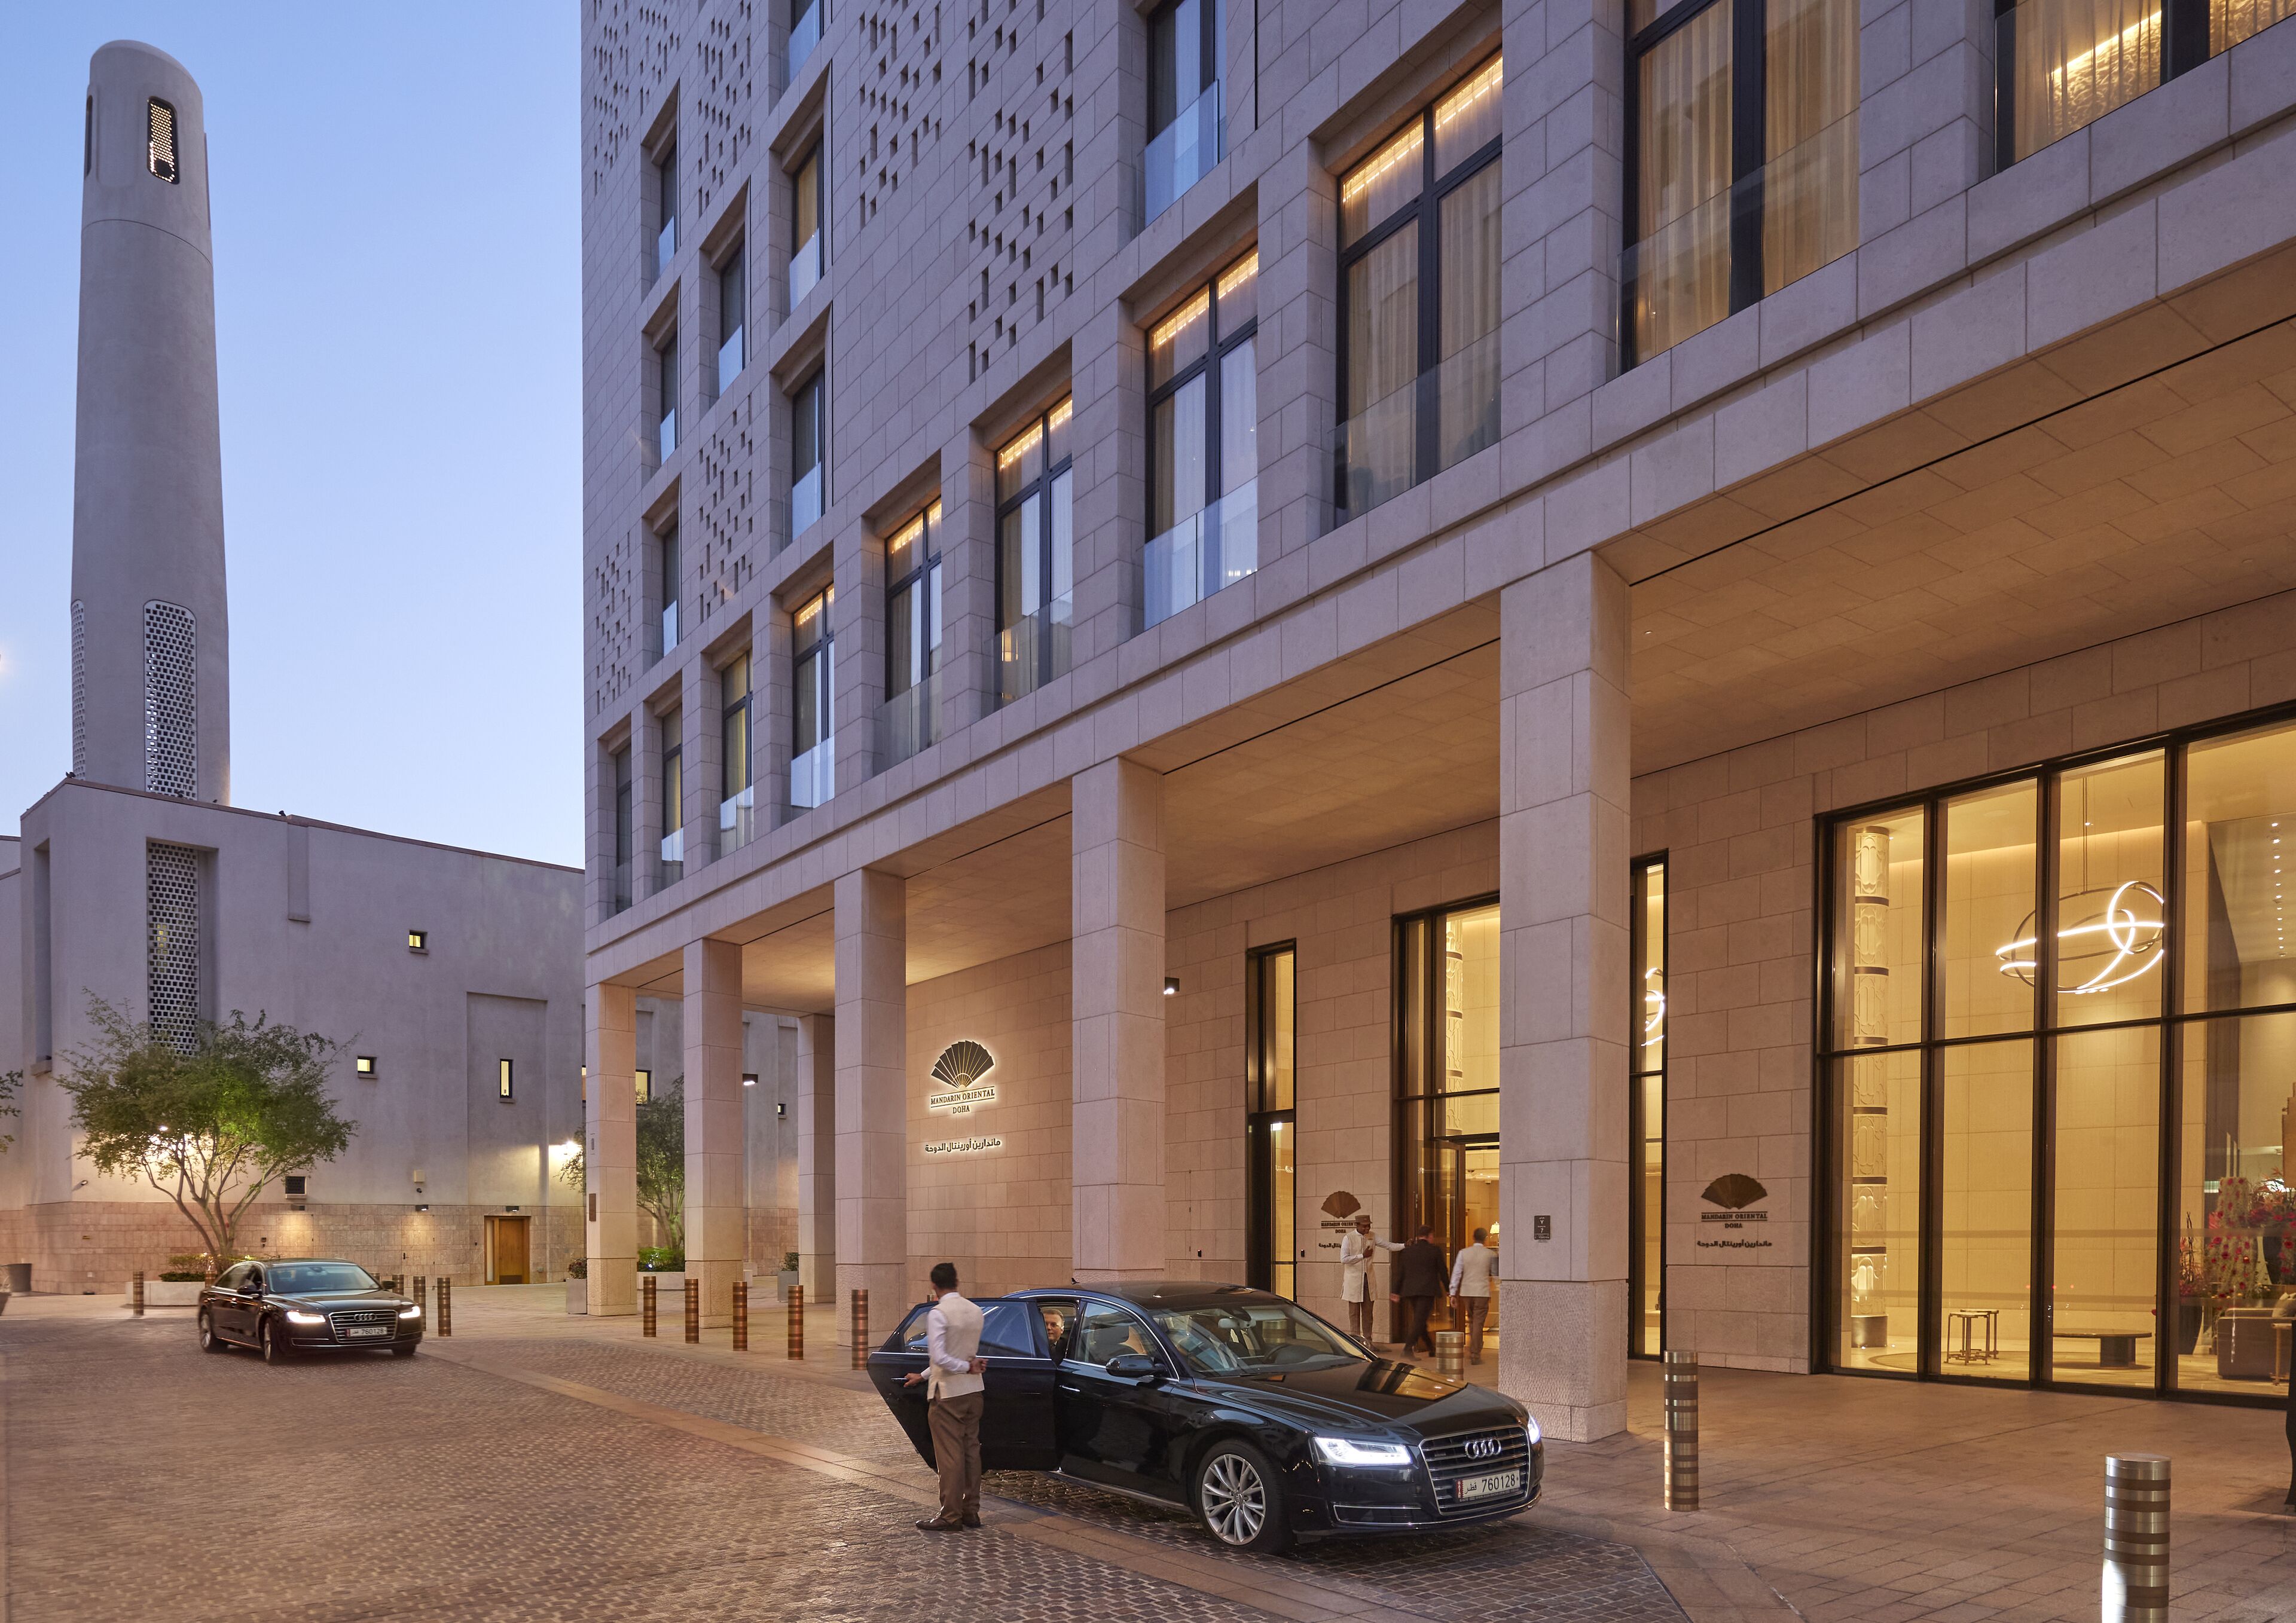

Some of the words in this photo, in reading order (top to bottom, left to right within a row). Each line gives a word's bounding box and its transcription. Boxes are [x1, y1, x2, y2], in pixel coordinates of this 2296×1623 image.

[930, 1093, 961, 1105] MANDARIN
[962, 1089, 995, 1101] ORIENTAL
[952, 1105, 970, 1114] DOHA
[925, 1142, 946, 1154] الدوحة
[947, 1138, 972, 1153] أورينتال
[972, 1138, 1001, 1150] ماندارين
[1464, 1482, 1477, 1494] قطر
[1482, 1474, 1516, 1493] 760128
